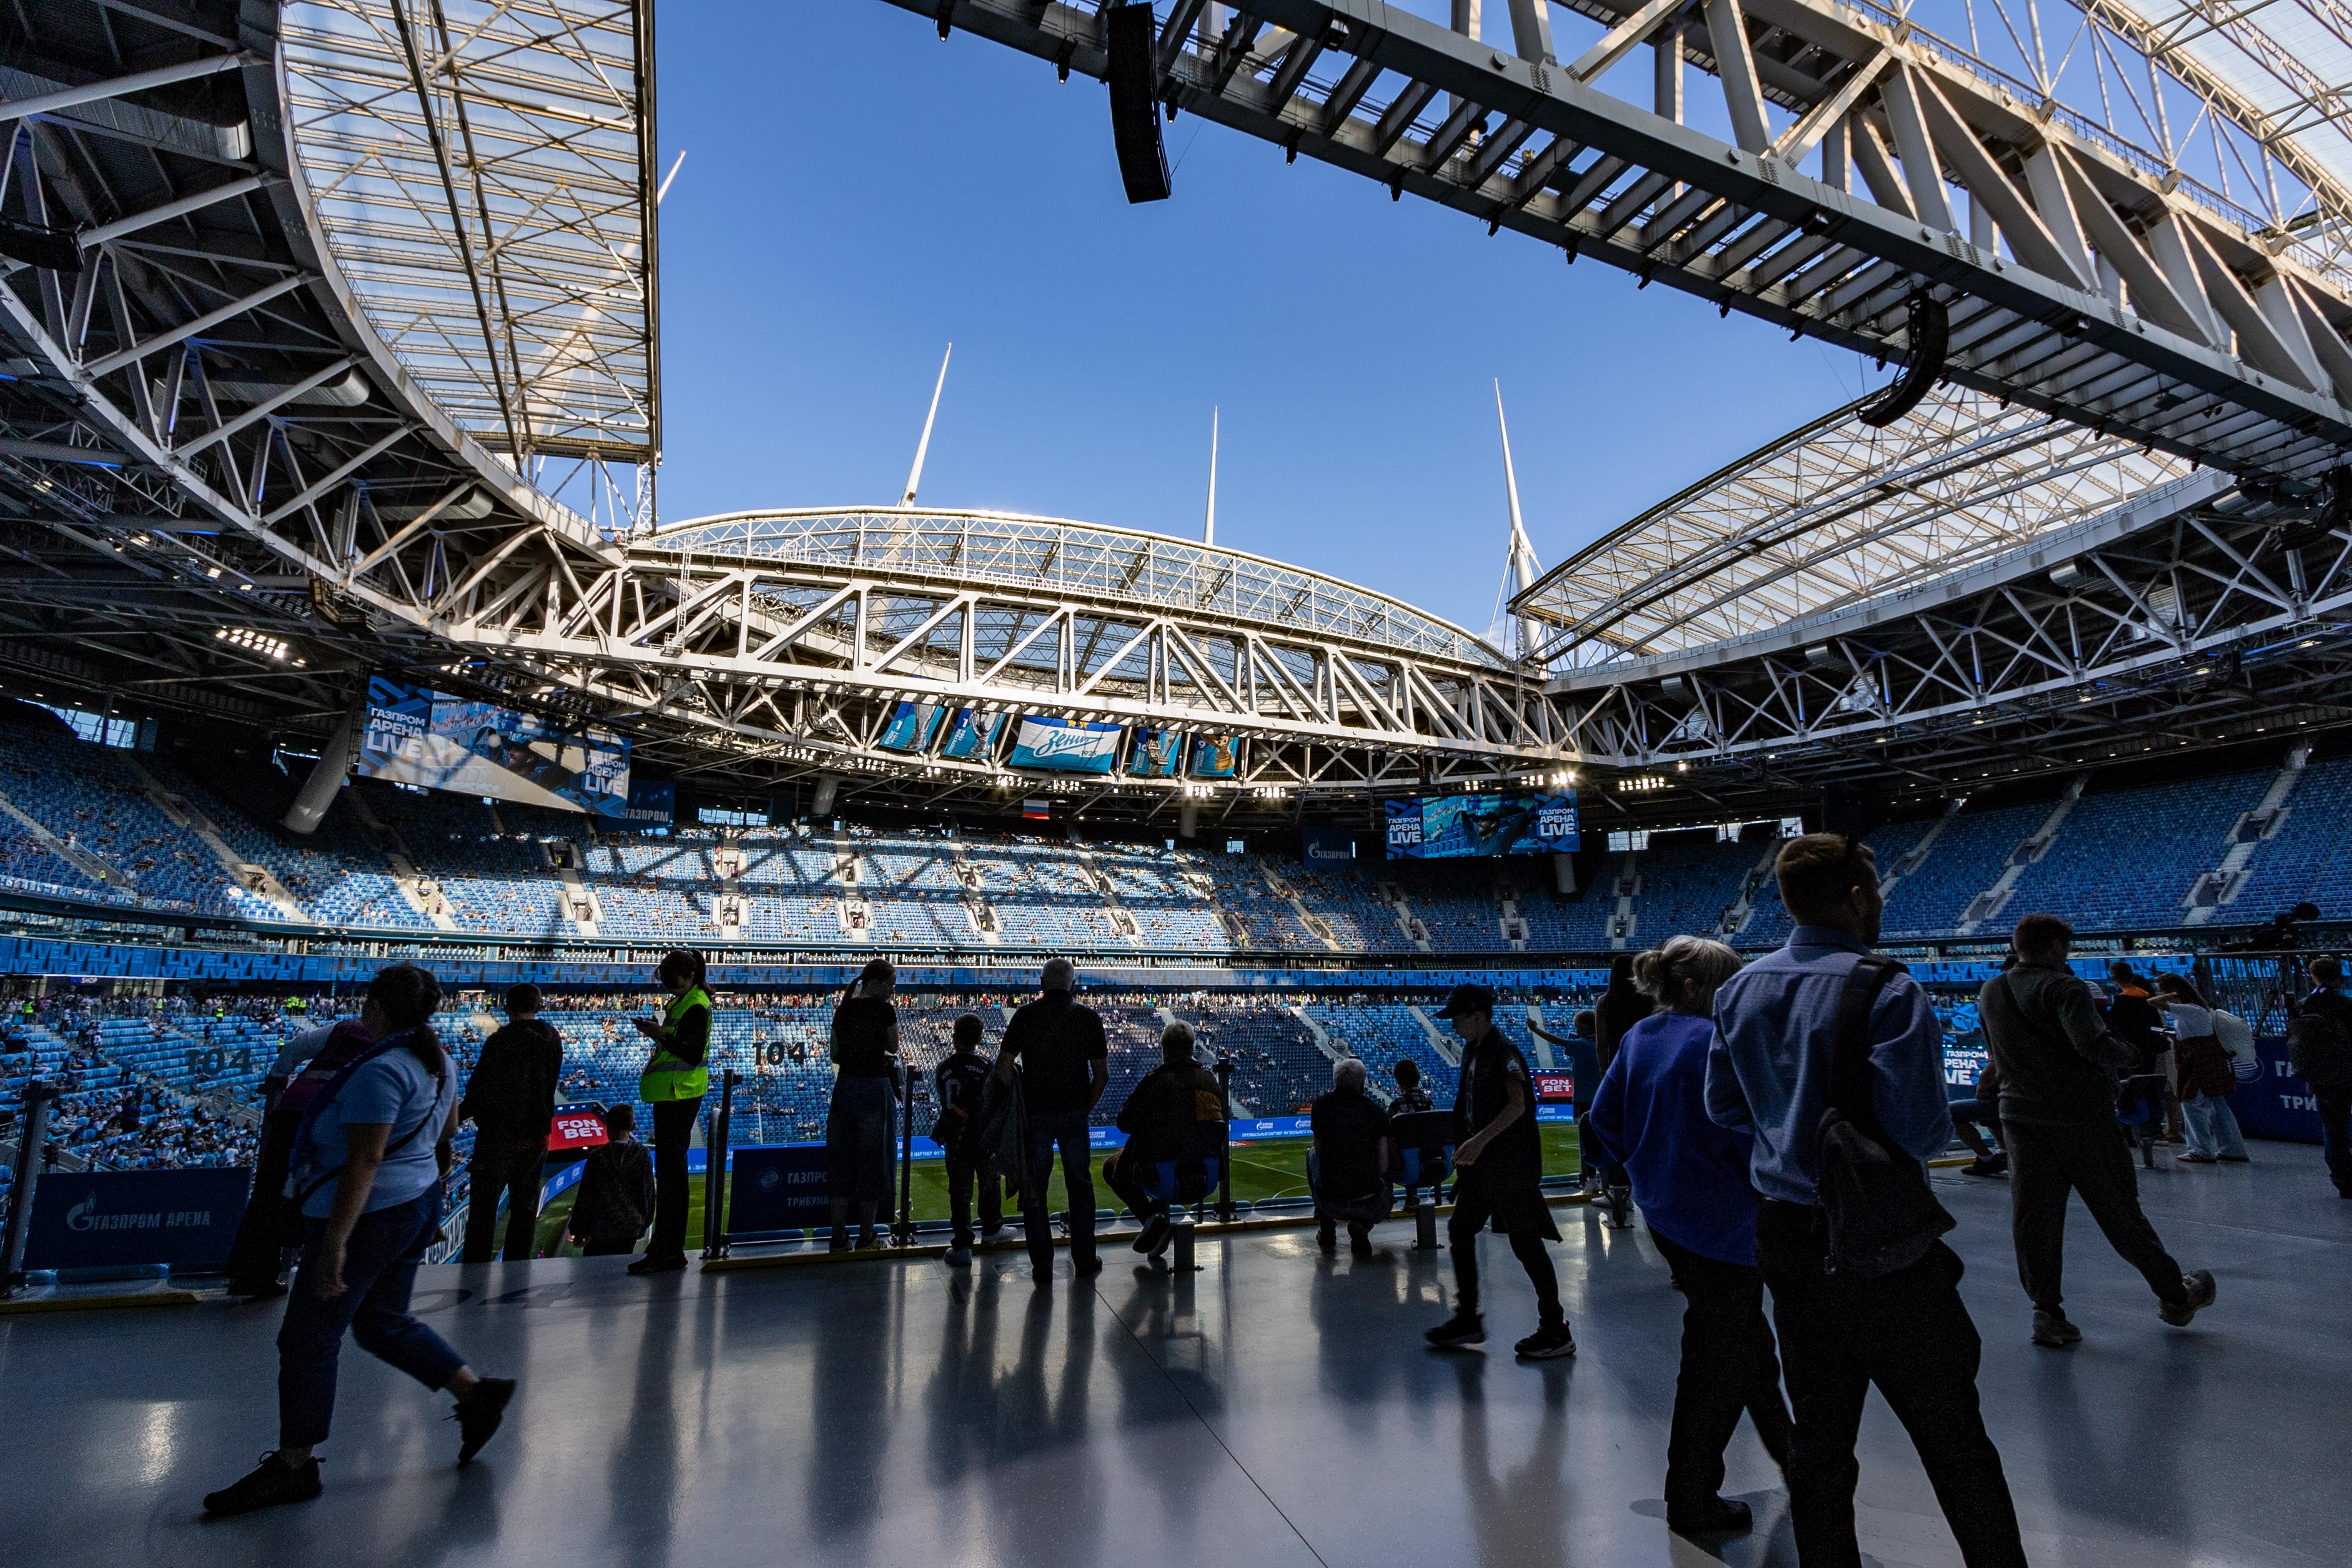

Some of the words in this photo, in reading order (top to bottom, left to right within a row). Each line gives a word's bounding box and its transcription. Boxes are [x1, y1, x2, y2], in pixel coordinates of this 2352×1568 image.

[371, 708, 425, 726] ГАЗПРОМ
[370, 719, 423, 739] АРЕНА
[367, 731, 423, 759] LIVE
[1198, 740, 1206, 749] 9
[588, 755, 626, 769] ГАЗПРОМ
[586, 764, 625, 780] АРЕНА
[585, 774, 626, 797] LIVE
[625, 809, 669, 822] ГАЗПРОМ
[1539, 815, 1574, 824] АРЕНА
[1389, 823, 1421, 832] АРЕНА
[1539, 823, 1575, 836] LIVE
[1389, 831, 1421, 844] LIVE
[752, 1041, 806, 1066] 104
[1944, 1058, 1979, 1070] РЕНА
[1944, 1069, 1974, 1085] VE
[1544, 1085, 1573, 1093] BET
[557, 1119, 599, 1130] FON
[563, 1127, 604, 1140] BET
[787, 1195, 830, 1208] ТРИБУНА
[94, 1213, 162, 1231] ГАЗПРОМ
[165, 1210, 211, 1228] АРЕНА
